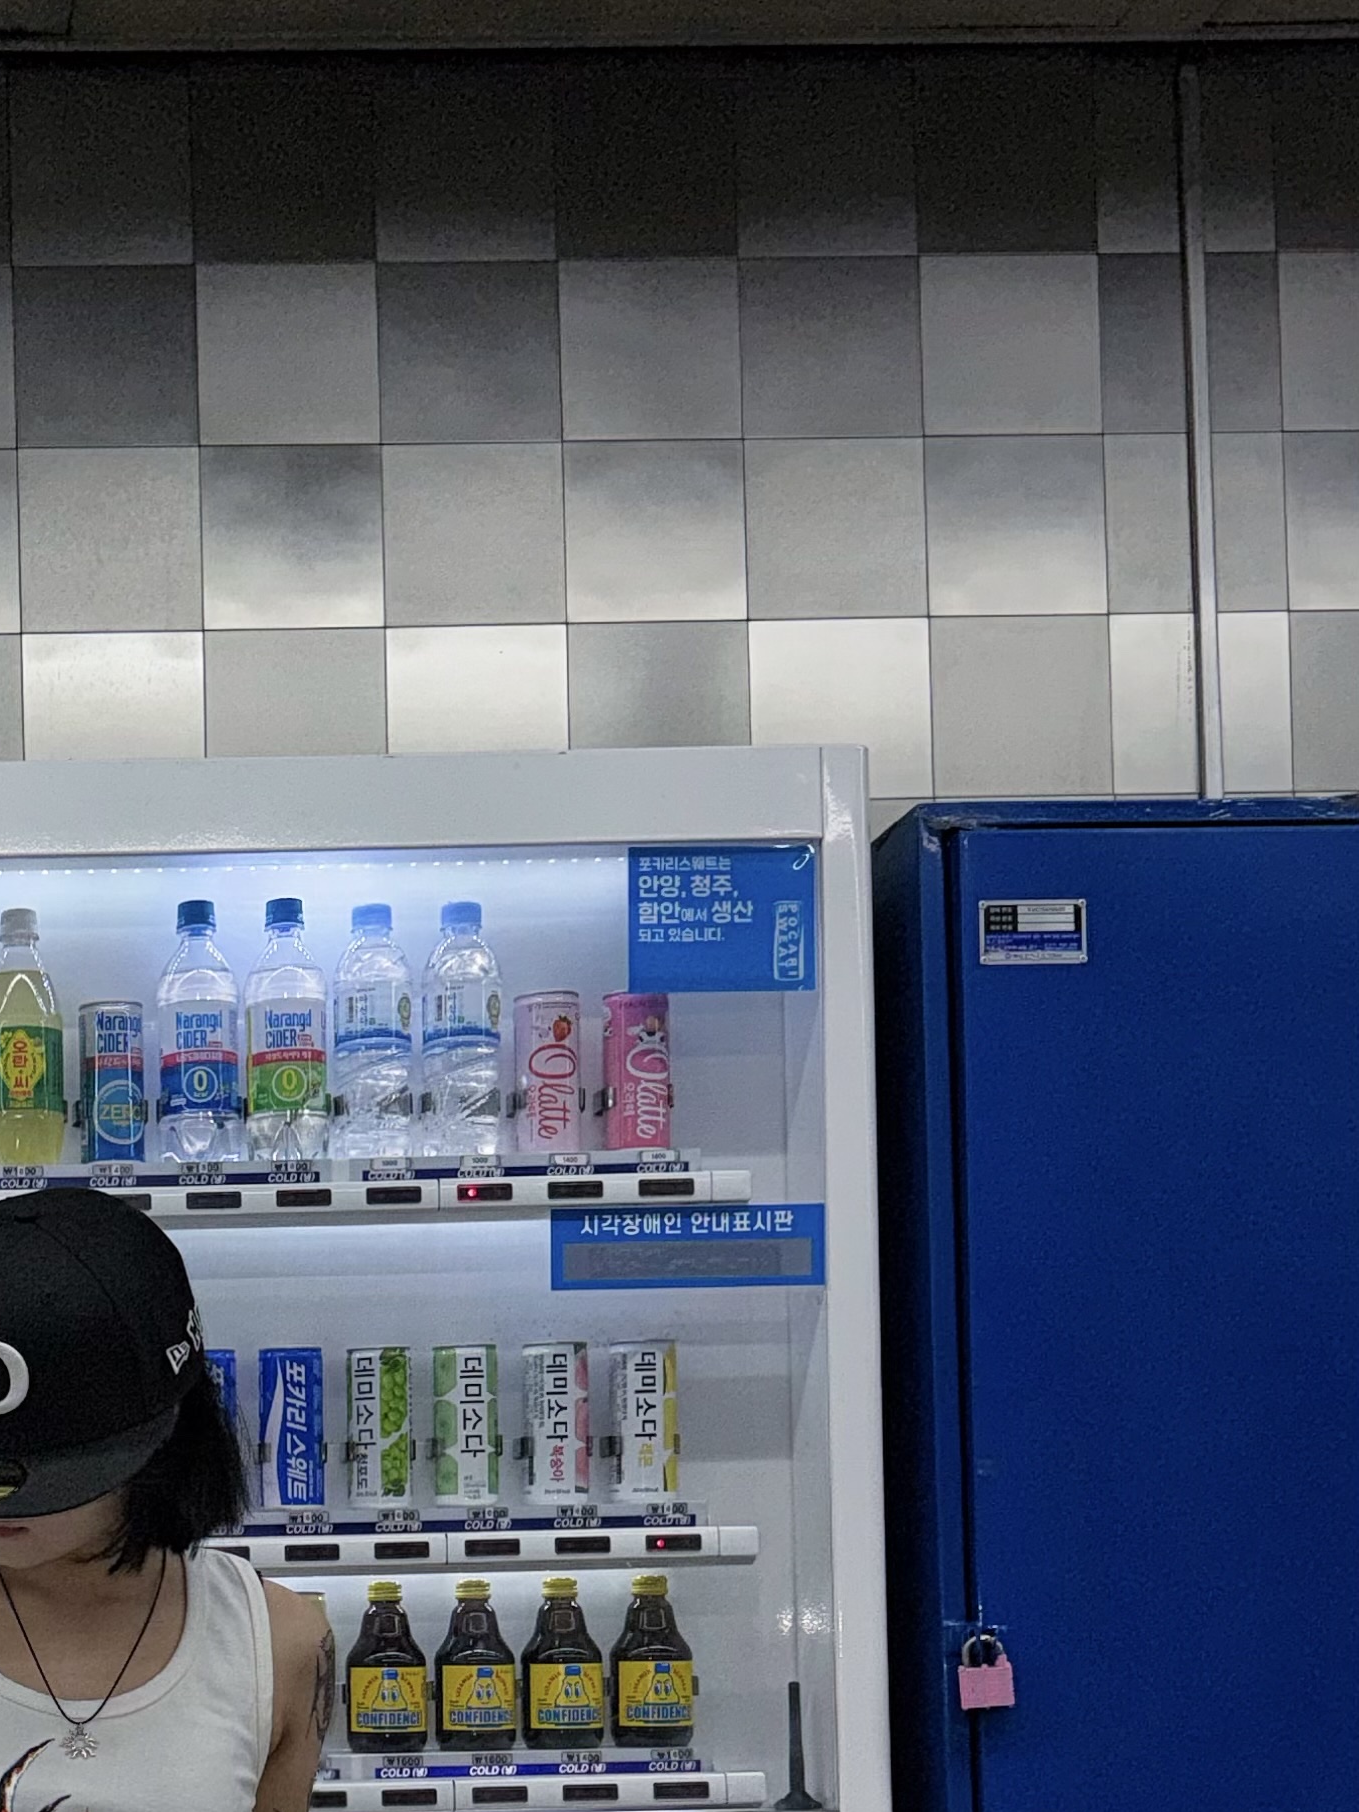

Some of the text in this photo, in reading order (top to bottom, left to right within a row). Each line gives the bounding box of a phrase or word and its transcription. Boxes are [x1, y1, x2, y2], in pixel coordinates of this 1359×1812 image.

[639, 856, 731, 872] 포카리스웨트는
[638, 874, 739, 898] 안양, 청주,
[638, 901, 754, 924] 함안에서 생산
[638, 928, 725, 942] 되고 있습니다.
[193, 1069, 208, 1092] 0
[281, 1069, 297, 1092] 0
[99, 1104, 141, 1121] ZERO
[458, 1168, 488, 1177] COLD
[547, 1166, 576, 1175] COLD
[637, 1163, 666, 1173] COLD
[179, 1175, 208, 1185] COLD
[268, 1173, 297, 1183] COLD
[368, 1171, 398, 1180] COLD
[1, 1178, 29, 1188] COLD
[90, 1176, 119, 1186] COLD
[580, 1210, 794, 1236] 시각장애인 안내표시판
[546, 1353, 569, 1442] 데미소다
[634, 1351, 657, 1441] 데미소다
[354, 1357, 377, 1451] 데미소다
[459, 1357, 485, 1458] 데미소다
[465, 1520, 494, 1530] COLD
[554, 1518, 583, 1528] COLD
[643, 1516, 673, 1525] COLD
[286, 1524, 315, 1534] COLD
[375, 1522, 404, 1532] COLD
[469, 1766, 499, 1775] COLD
[559, 1764, 588, 1773] COLD
[649, 1762, 678, 1771] COLD
[380, 1768, 410, 1778] COLD
